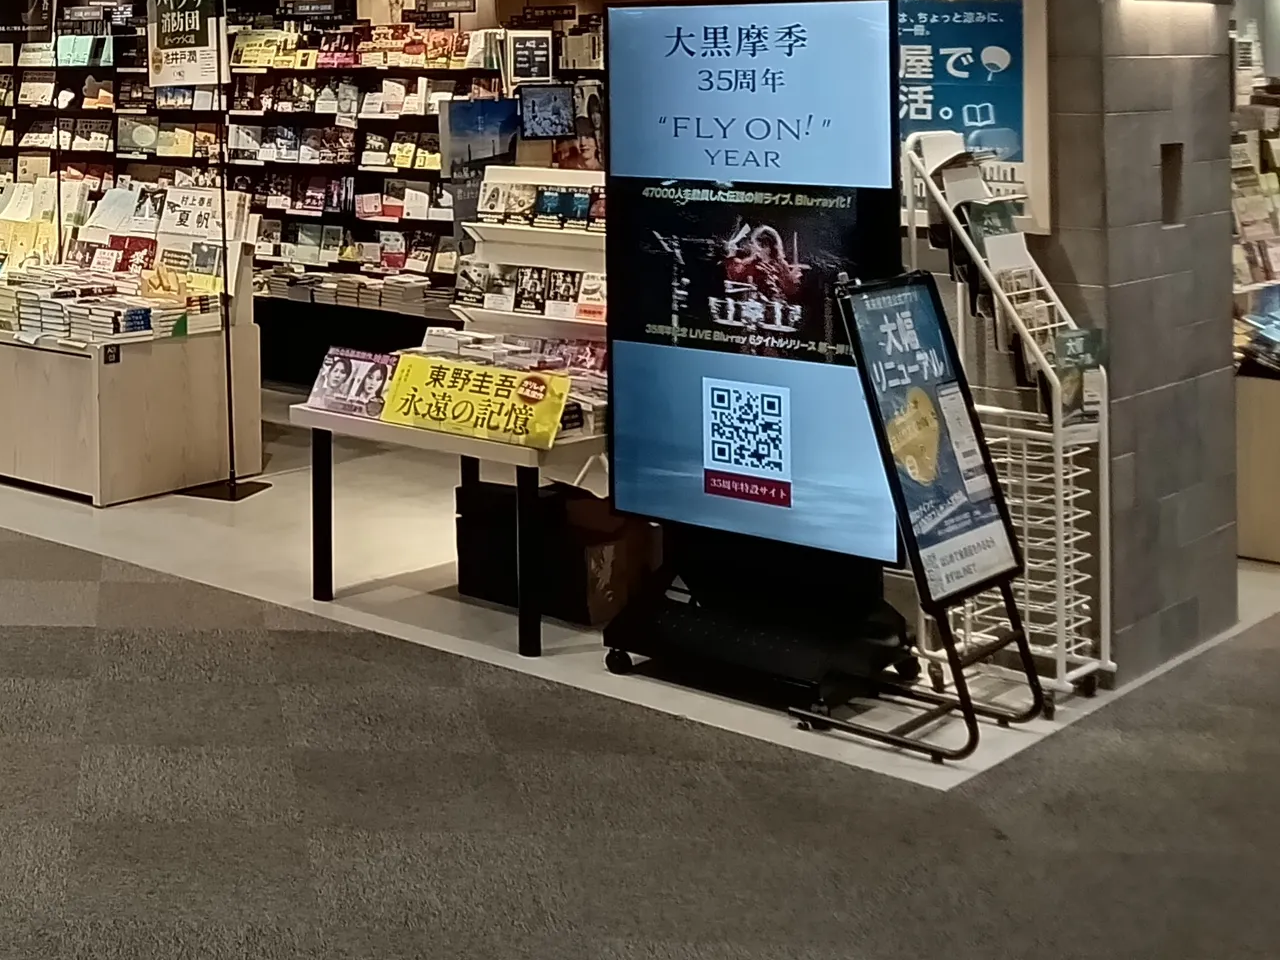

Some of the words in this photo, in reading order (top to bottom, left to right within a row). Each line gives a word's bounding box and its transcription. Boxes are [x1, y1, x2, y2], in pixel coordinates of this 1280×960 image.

[160, 10, 201, 34] 消防団
[663, 23, 809, 59] 大黒摩季
[696, 68, 787, 94] 35周年
[703, 148, 782, 169] YEAR
[424, 364, 518, 399] 東野圭吾
[871, 347, 945, 393] リニューアル
[395, 386, 535, 437] 永遠の記憶
[709, 478, 788, 500] 35周年特設サイト
